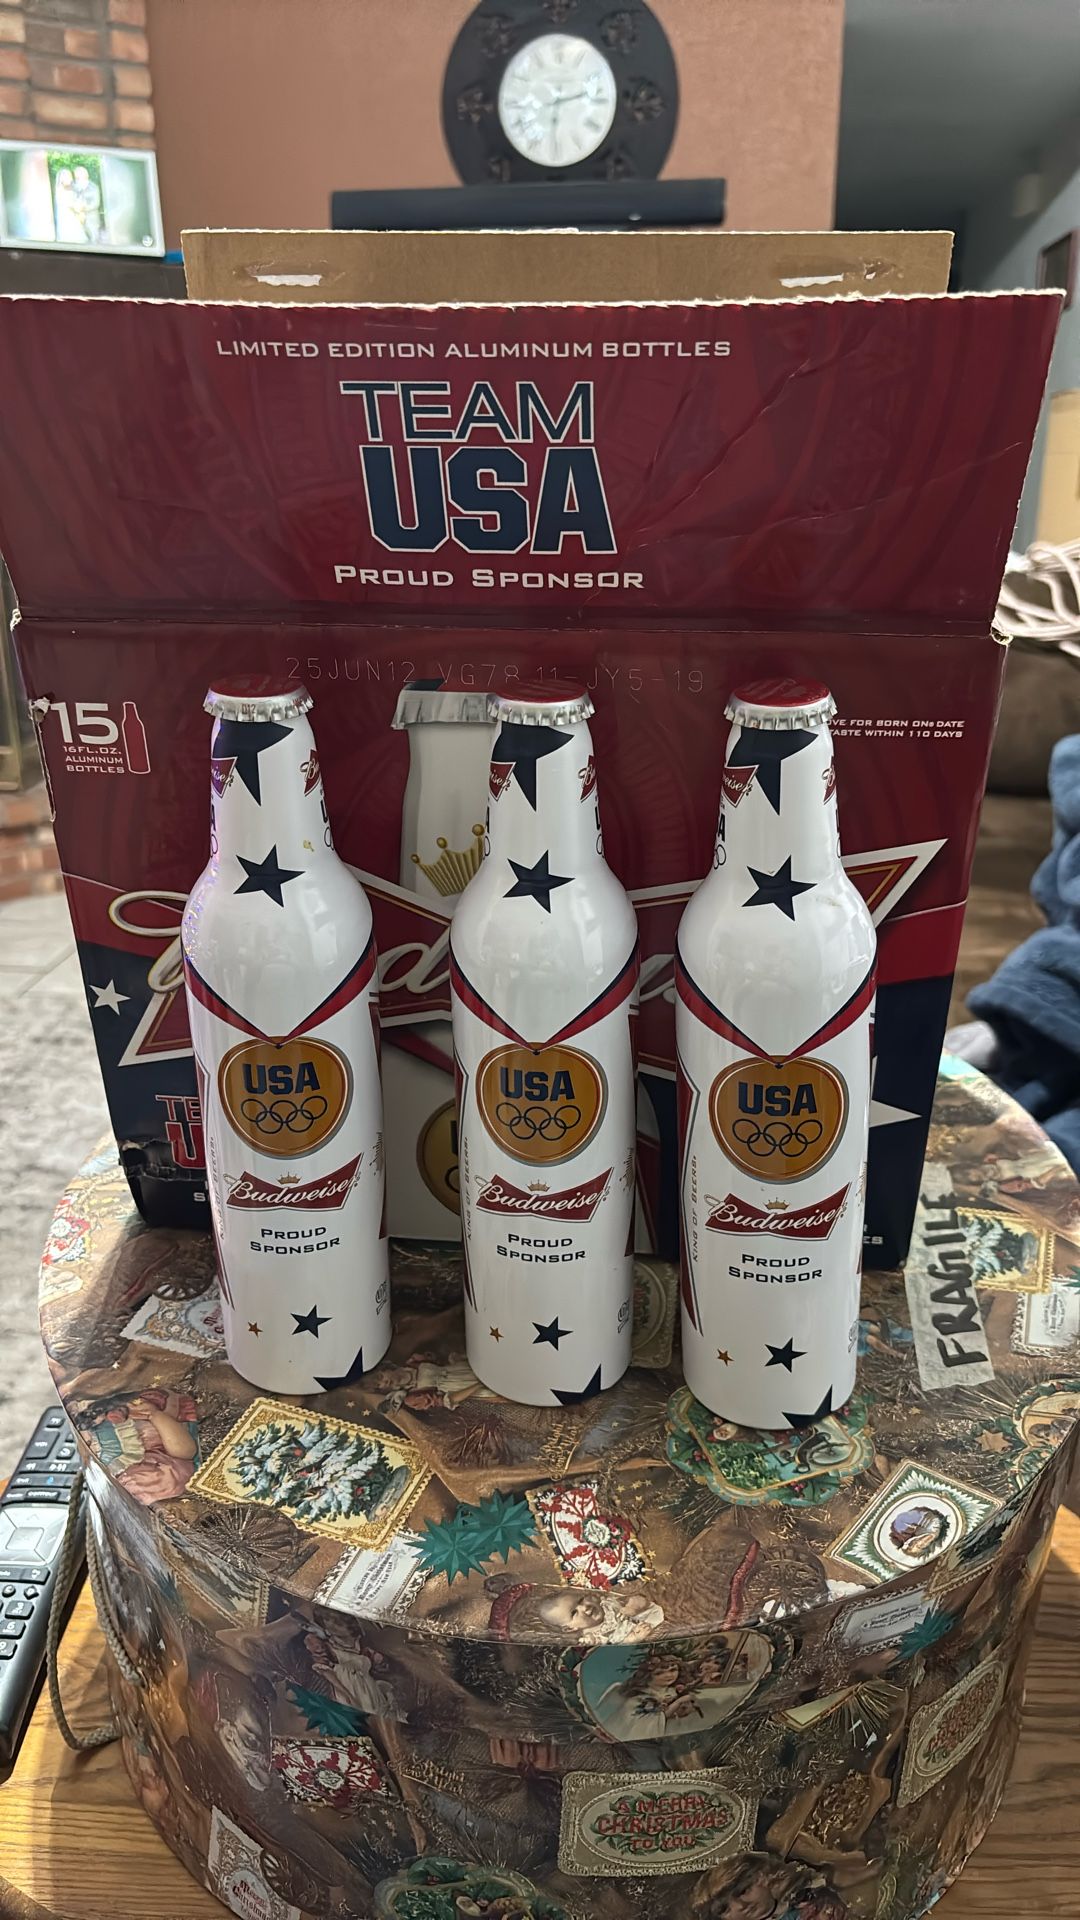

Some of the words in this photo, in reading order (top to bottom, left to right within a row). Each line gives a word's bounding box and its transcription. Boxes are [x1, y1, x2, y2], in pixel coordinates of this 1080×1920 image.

[216, 340, 319, 358] LIMITED
[328, 342, 434, 358] EDITION
[444, 342, 593, 358] ALUMINUM
[602, 341, 731, 357] BOTTLES
[340, 381, 595, 443] TEAM
[359, 445, 617, 554] USA
[286, 657, 415, 684] 25JUN12
[50, 702, 119, 745] 15
[66, 755, 123, 764] ALUMINUM
[66, 765, 125, 774] BOTTLES
[243, 1062, 321, 1095] USA
[500, 1066, 575, 1102] USA
[738, 1081, 817, 1116] USA
[920, 1192, 988, 1368] FRAGILE
[599, 1809, 730, 1835] CHRISTMAS
